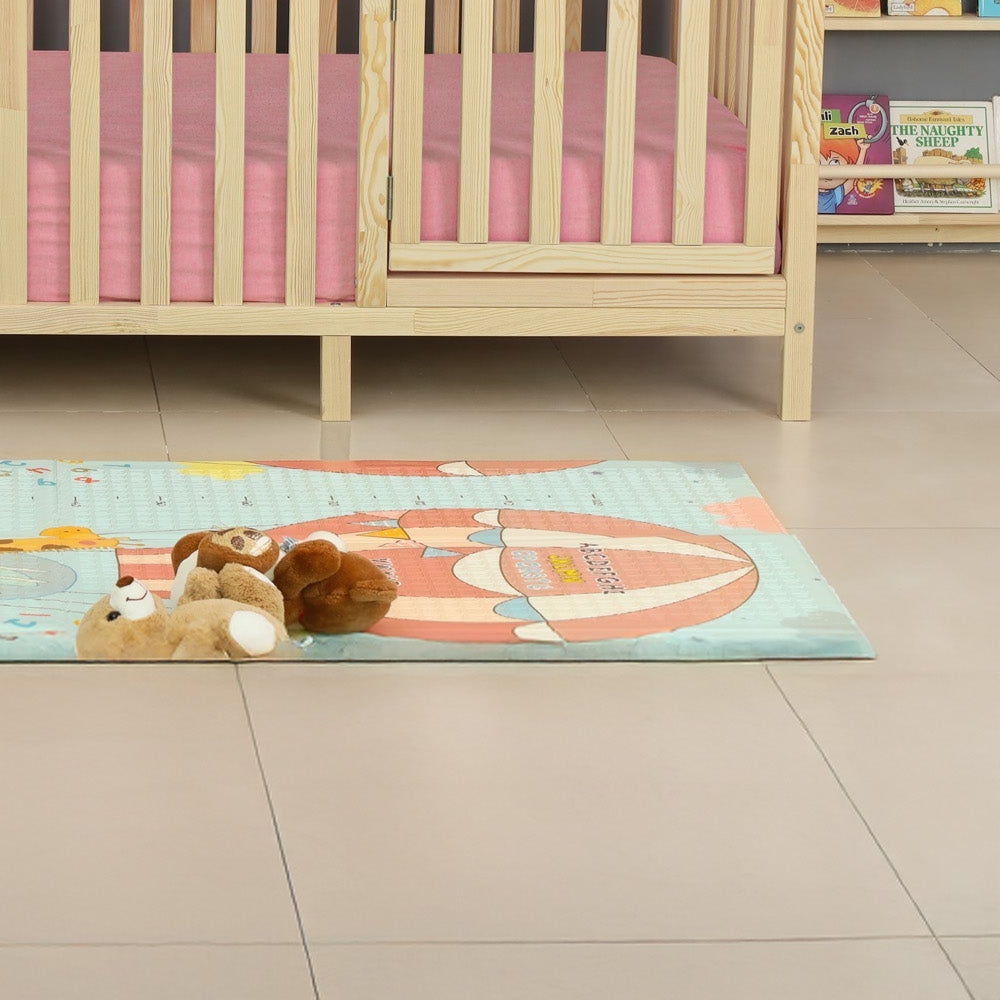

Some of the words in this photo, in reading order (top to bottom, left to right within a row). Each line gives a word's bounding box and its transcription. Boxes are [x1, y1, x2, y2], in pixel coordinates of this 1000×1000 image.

[892, 125, 918, 136] THE
[921, 125, 984, 136] NAUGHTY
[915, 136, 960, 148] SHEEP
